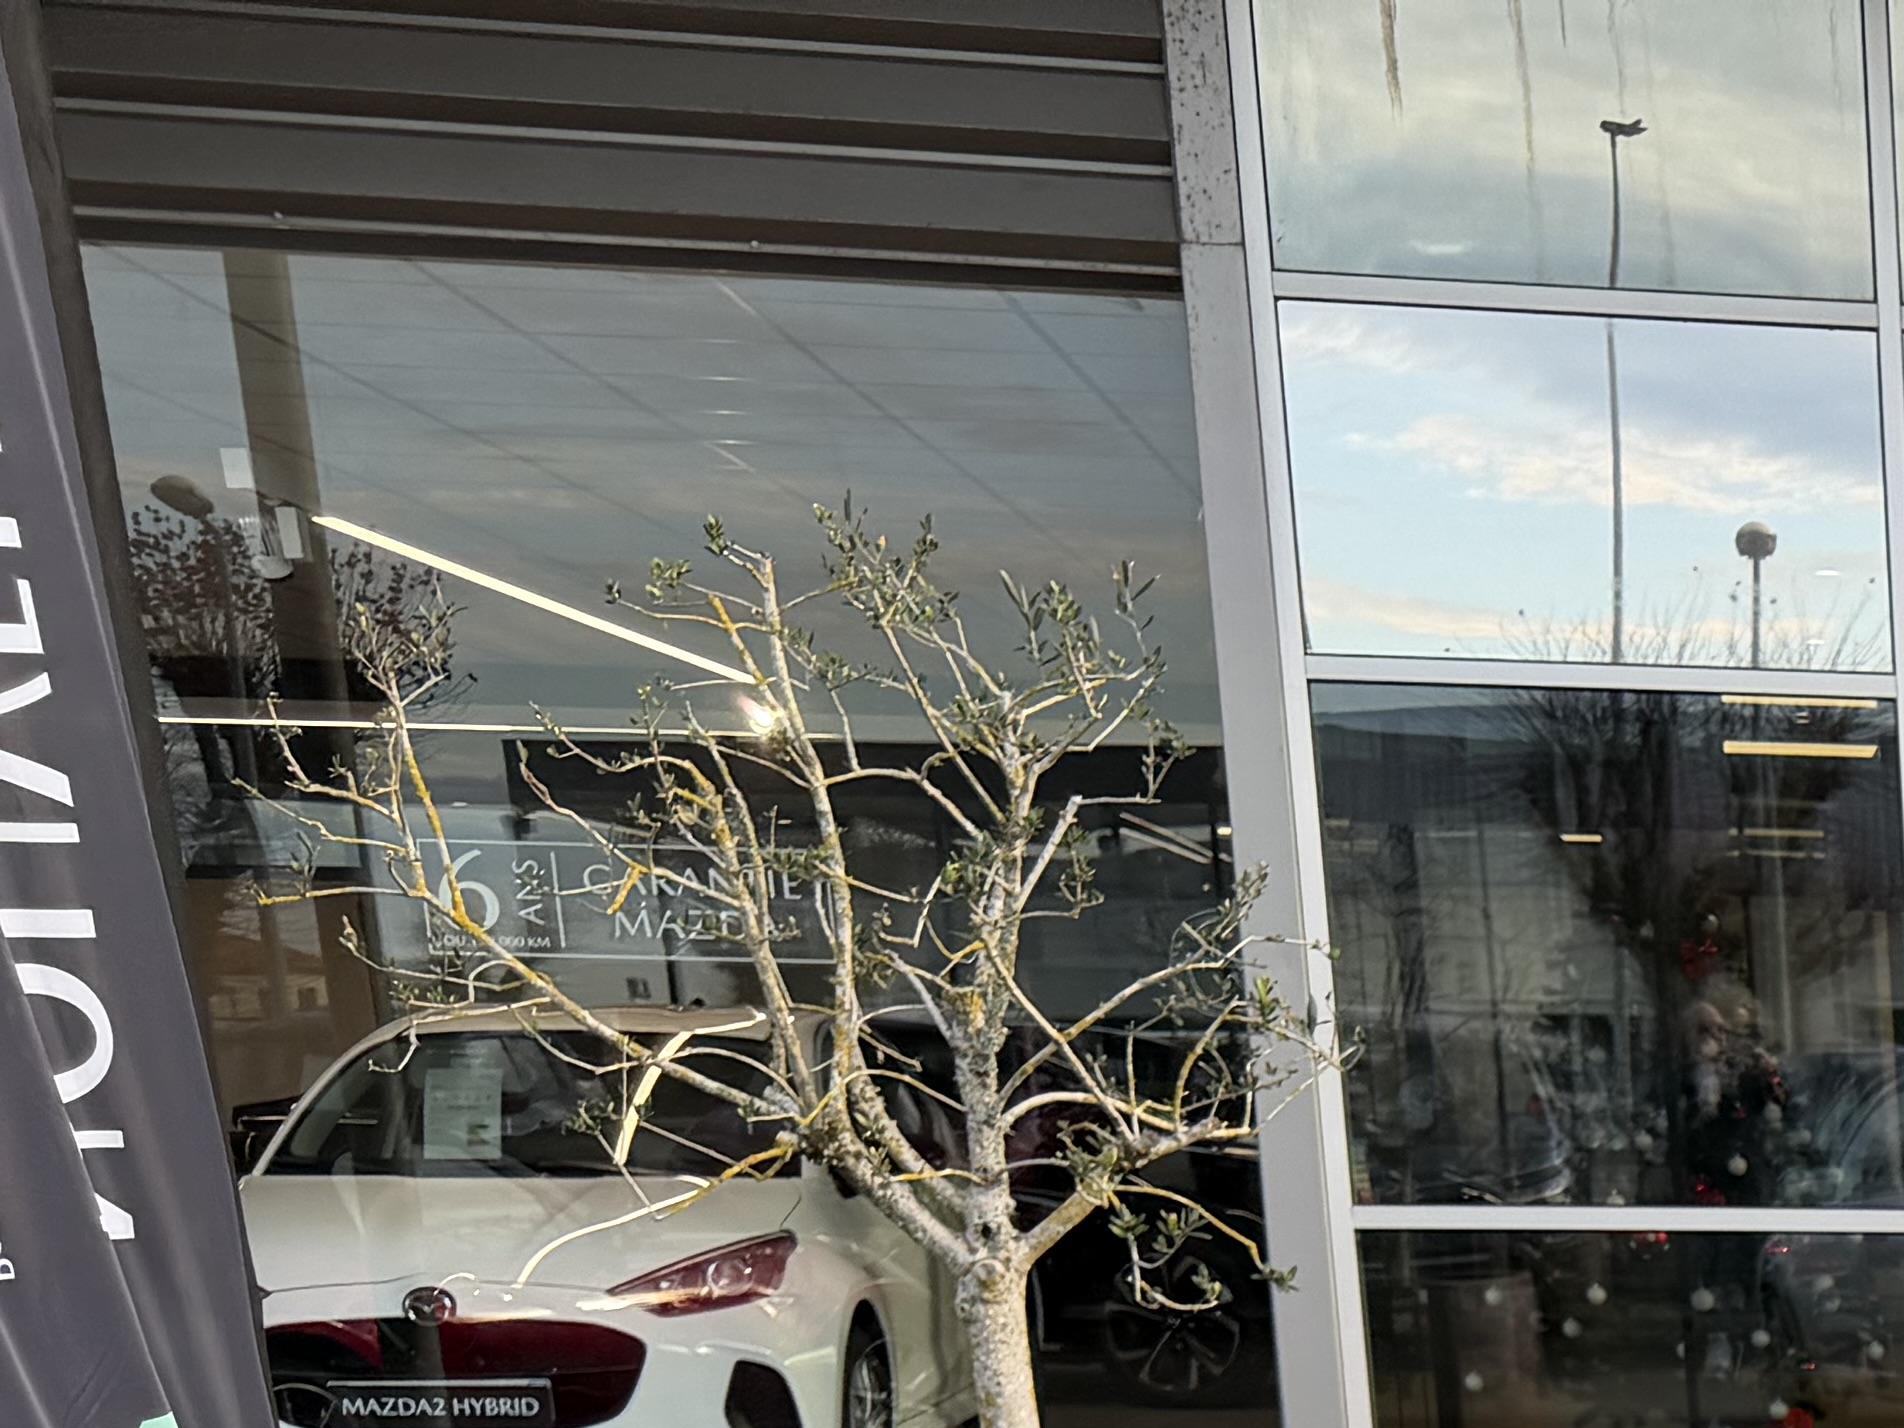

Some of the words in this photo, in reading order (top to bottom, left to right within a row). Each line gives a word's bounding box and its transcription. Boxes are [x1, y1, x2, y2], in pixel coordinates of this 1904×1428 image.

[438, 849, 500, 932] 6
[614, 909, 770, 941] MAZD
[342, 1397, 447, 1416] MAZDA2
[453, 1397, 540, 1416] HYBRID
